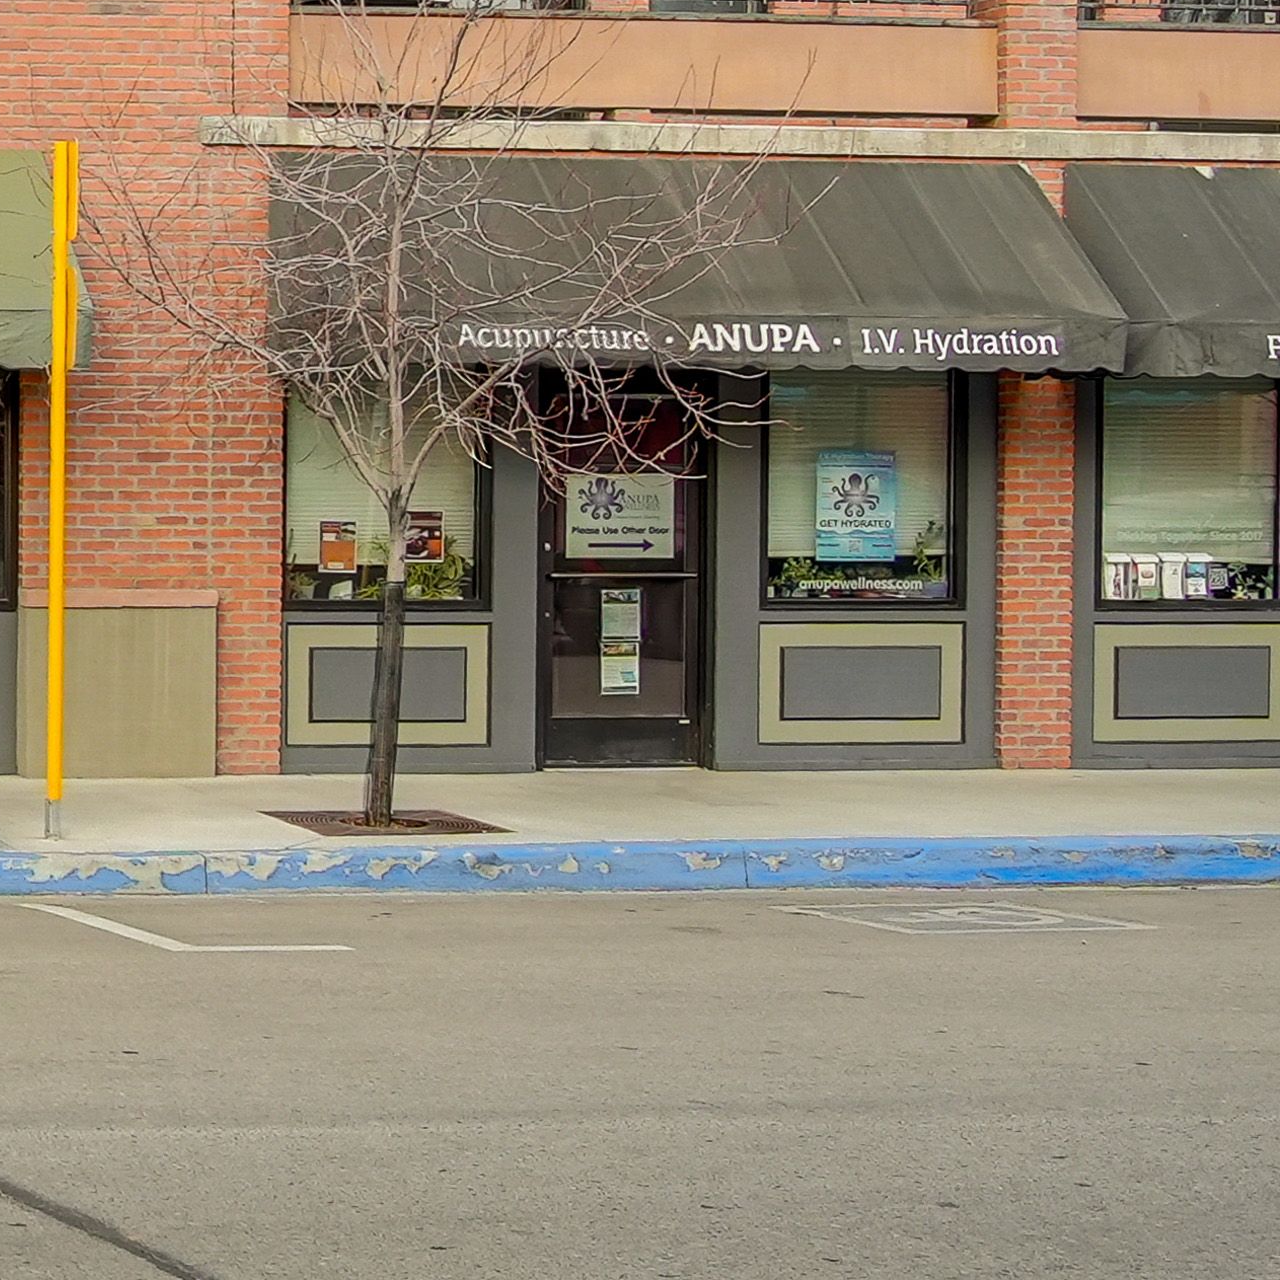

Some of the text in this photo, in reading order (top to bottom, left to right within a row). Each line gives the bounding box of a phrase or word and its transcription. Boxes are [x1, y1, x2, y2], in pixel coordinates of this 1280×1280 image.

[689, 323, 821, 353] ANUPA
[861, 328, 905, 354] I.V.
[913, 328, 1060, 361] Hydration
[820, 519, 892, 528] GET HYDRATED
[799, 577, 923, 592] anupawellness.com
